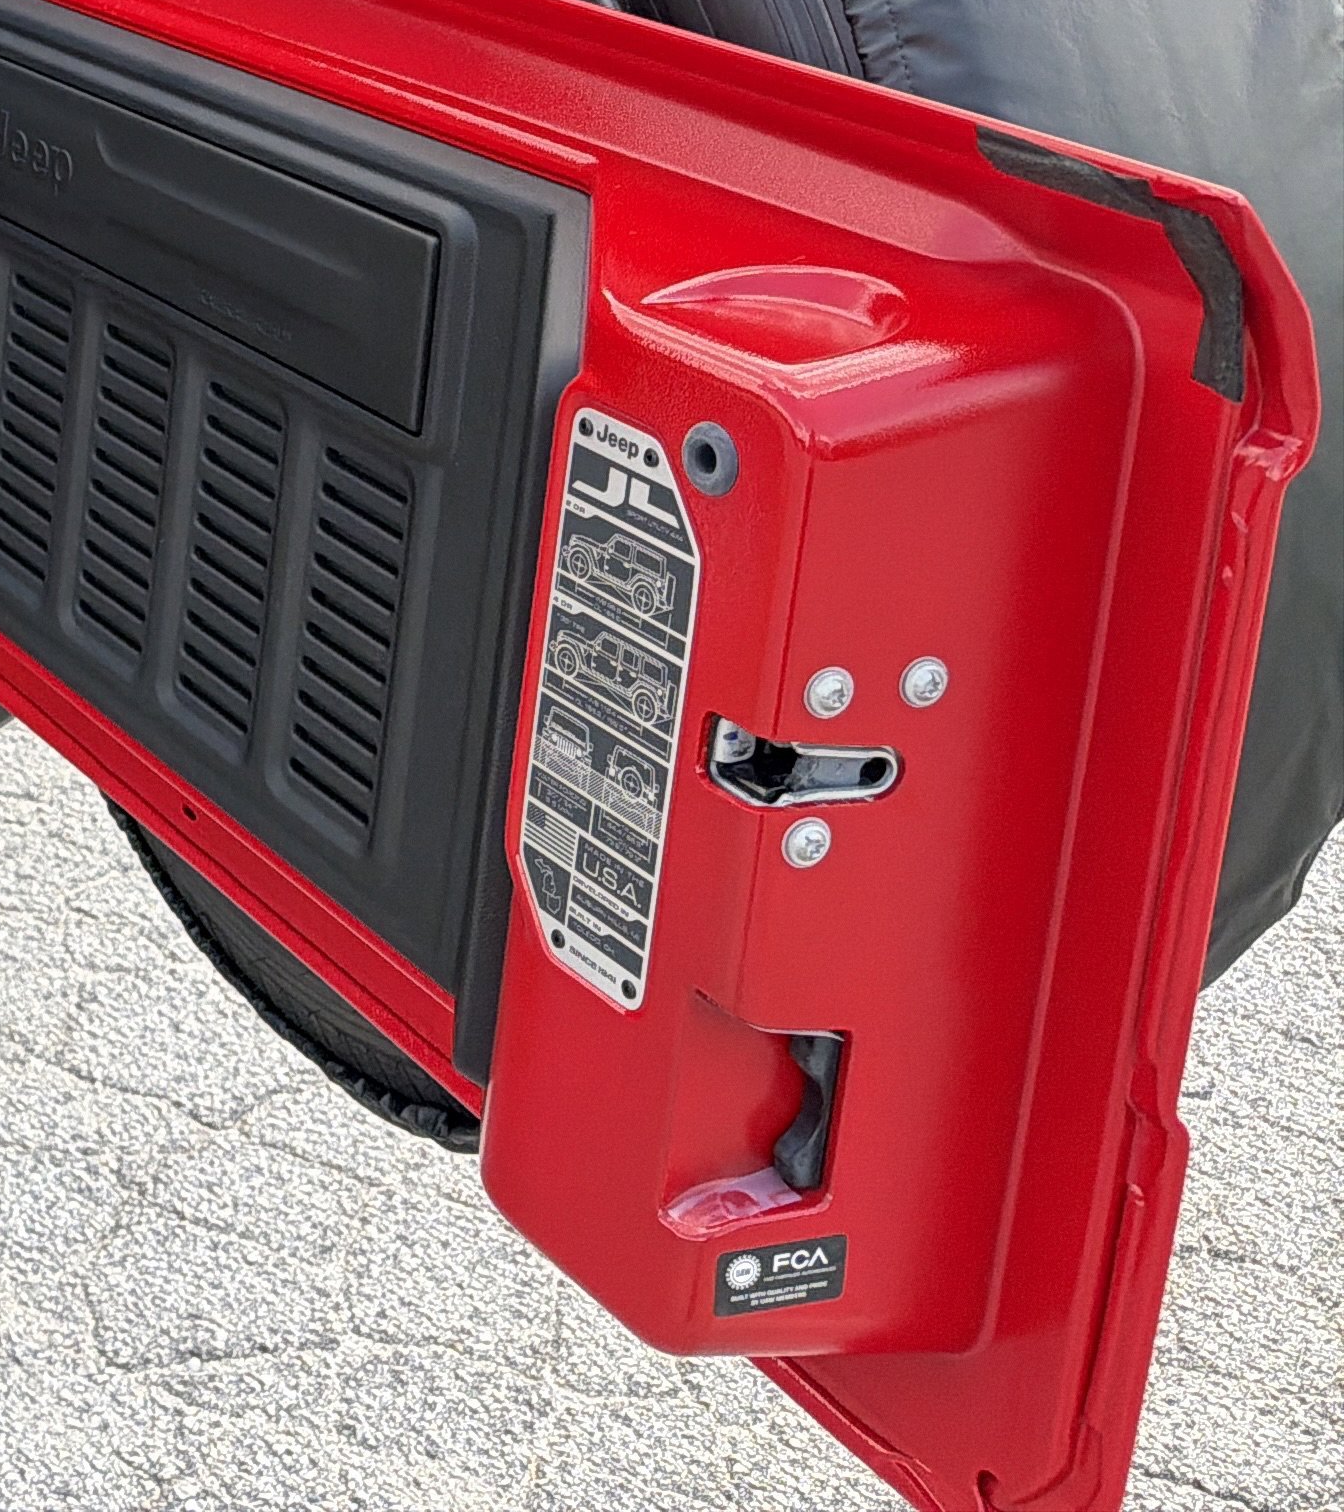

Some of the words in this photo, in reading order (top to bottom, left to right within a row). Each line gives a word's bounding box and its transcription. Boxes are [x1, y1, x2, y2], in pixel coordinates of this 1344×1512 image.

[596, 424, 639, 460] Jeep
[571, 466, 680, 529] JL
[582, 852, 642, 909] U.S.A.
[584, 842, 611, 866] MADE
[614, 863, 624, 875] IN
[627, 870, 645, 888] THE
[572, 875, 620, 912] DEVELOPED
[620, 906, 630, 918] IN
[569, 945, 597, 971] SINCE
[772, 1246, 829, 1273] FCA
